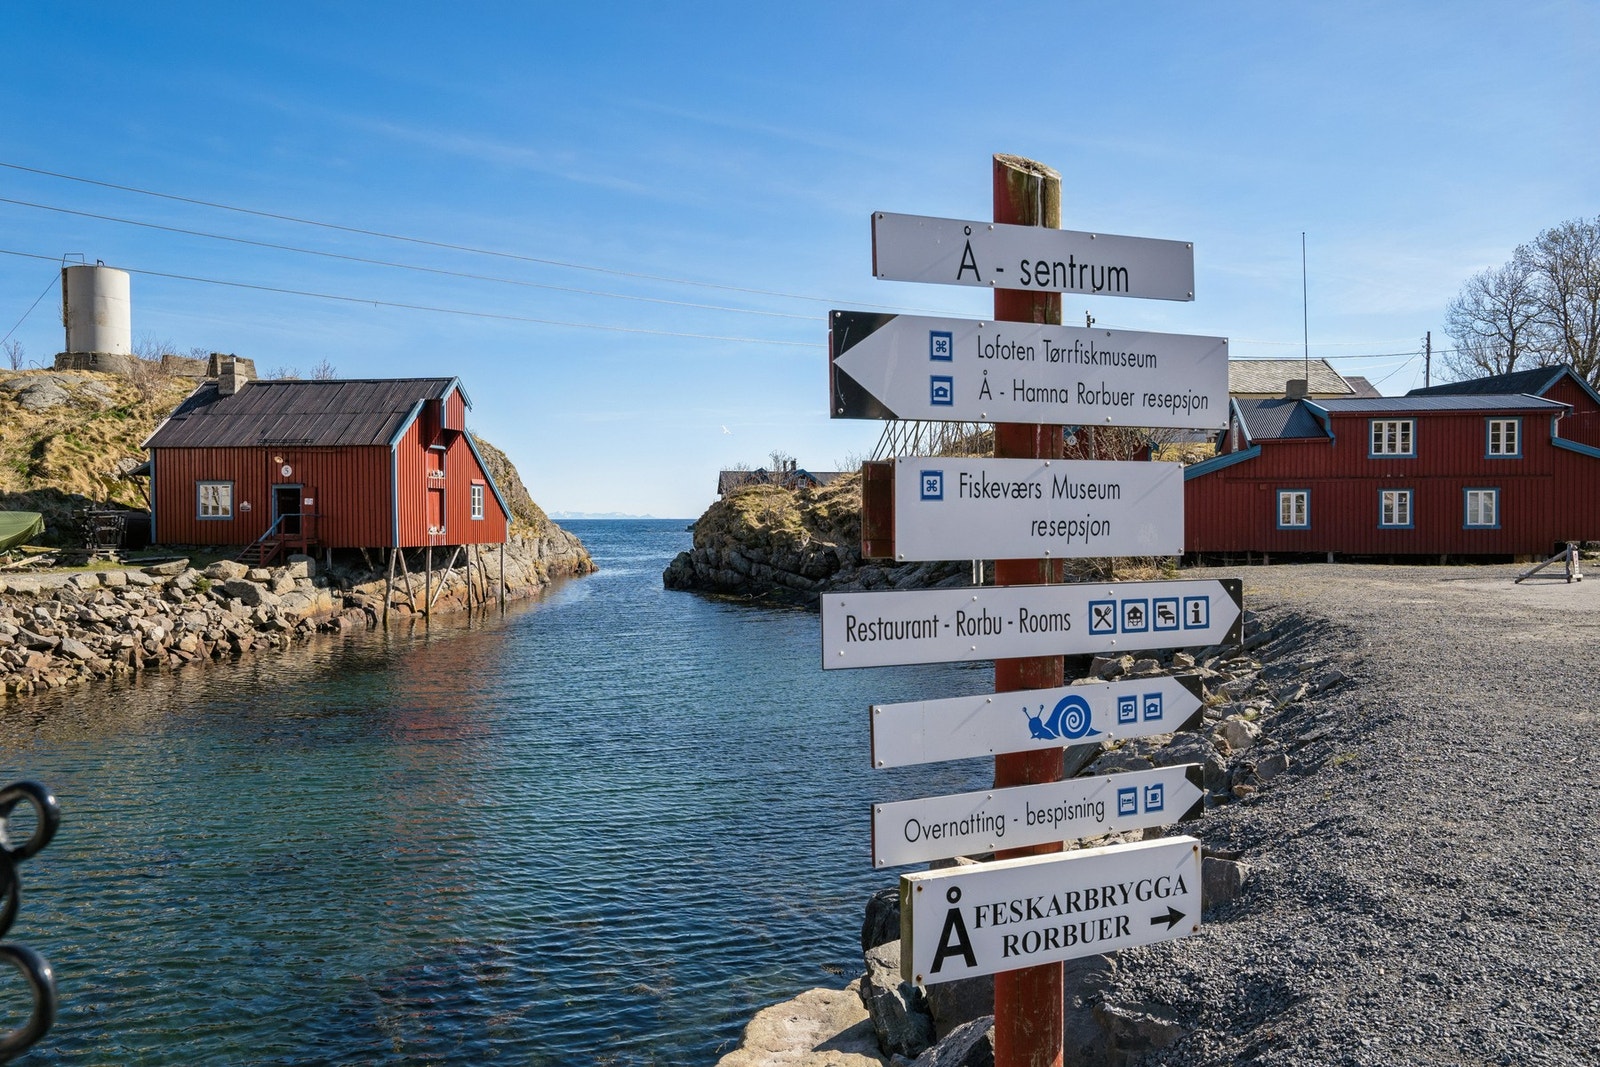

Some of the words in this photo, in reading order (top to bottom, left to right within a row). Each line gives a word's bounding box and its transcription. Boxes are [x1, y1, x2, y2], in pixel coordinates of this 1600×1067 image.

[957, 226, 981, 281] Å
[1020, 254, 1129, 292] sentrum
[977, 335, 1035, 361] Lofoten
[1043, 339, 1158, 368] Tørrfiskmuseum
[979, 370, 993, 400] Å
[1013, 379, 1068, 404] Hamna
[1077, 382, 1135, 407] Rorbuer
[1142, 389, 1209, 415] resepsjon
[959, 471, 1042, 499] Fiskeværs
[1052, 474, 1121, 500] Museum
[1031, 513, 1111, 544] resepsjon
[846, 614, 939, 643] Restaurant
[956, 607, 1002, 637] Rorbu
[1019, 607, 1071, 634] Rooms
[904, 811, 1006, 843] Overnatting
[1026, 797, 1105, 830] bespisning
[973, 874, 1189, 930] FESKARBRYGGA
[929, 886, 978, 974] Å
[1001, 915, 1131, 959] RORBUER
